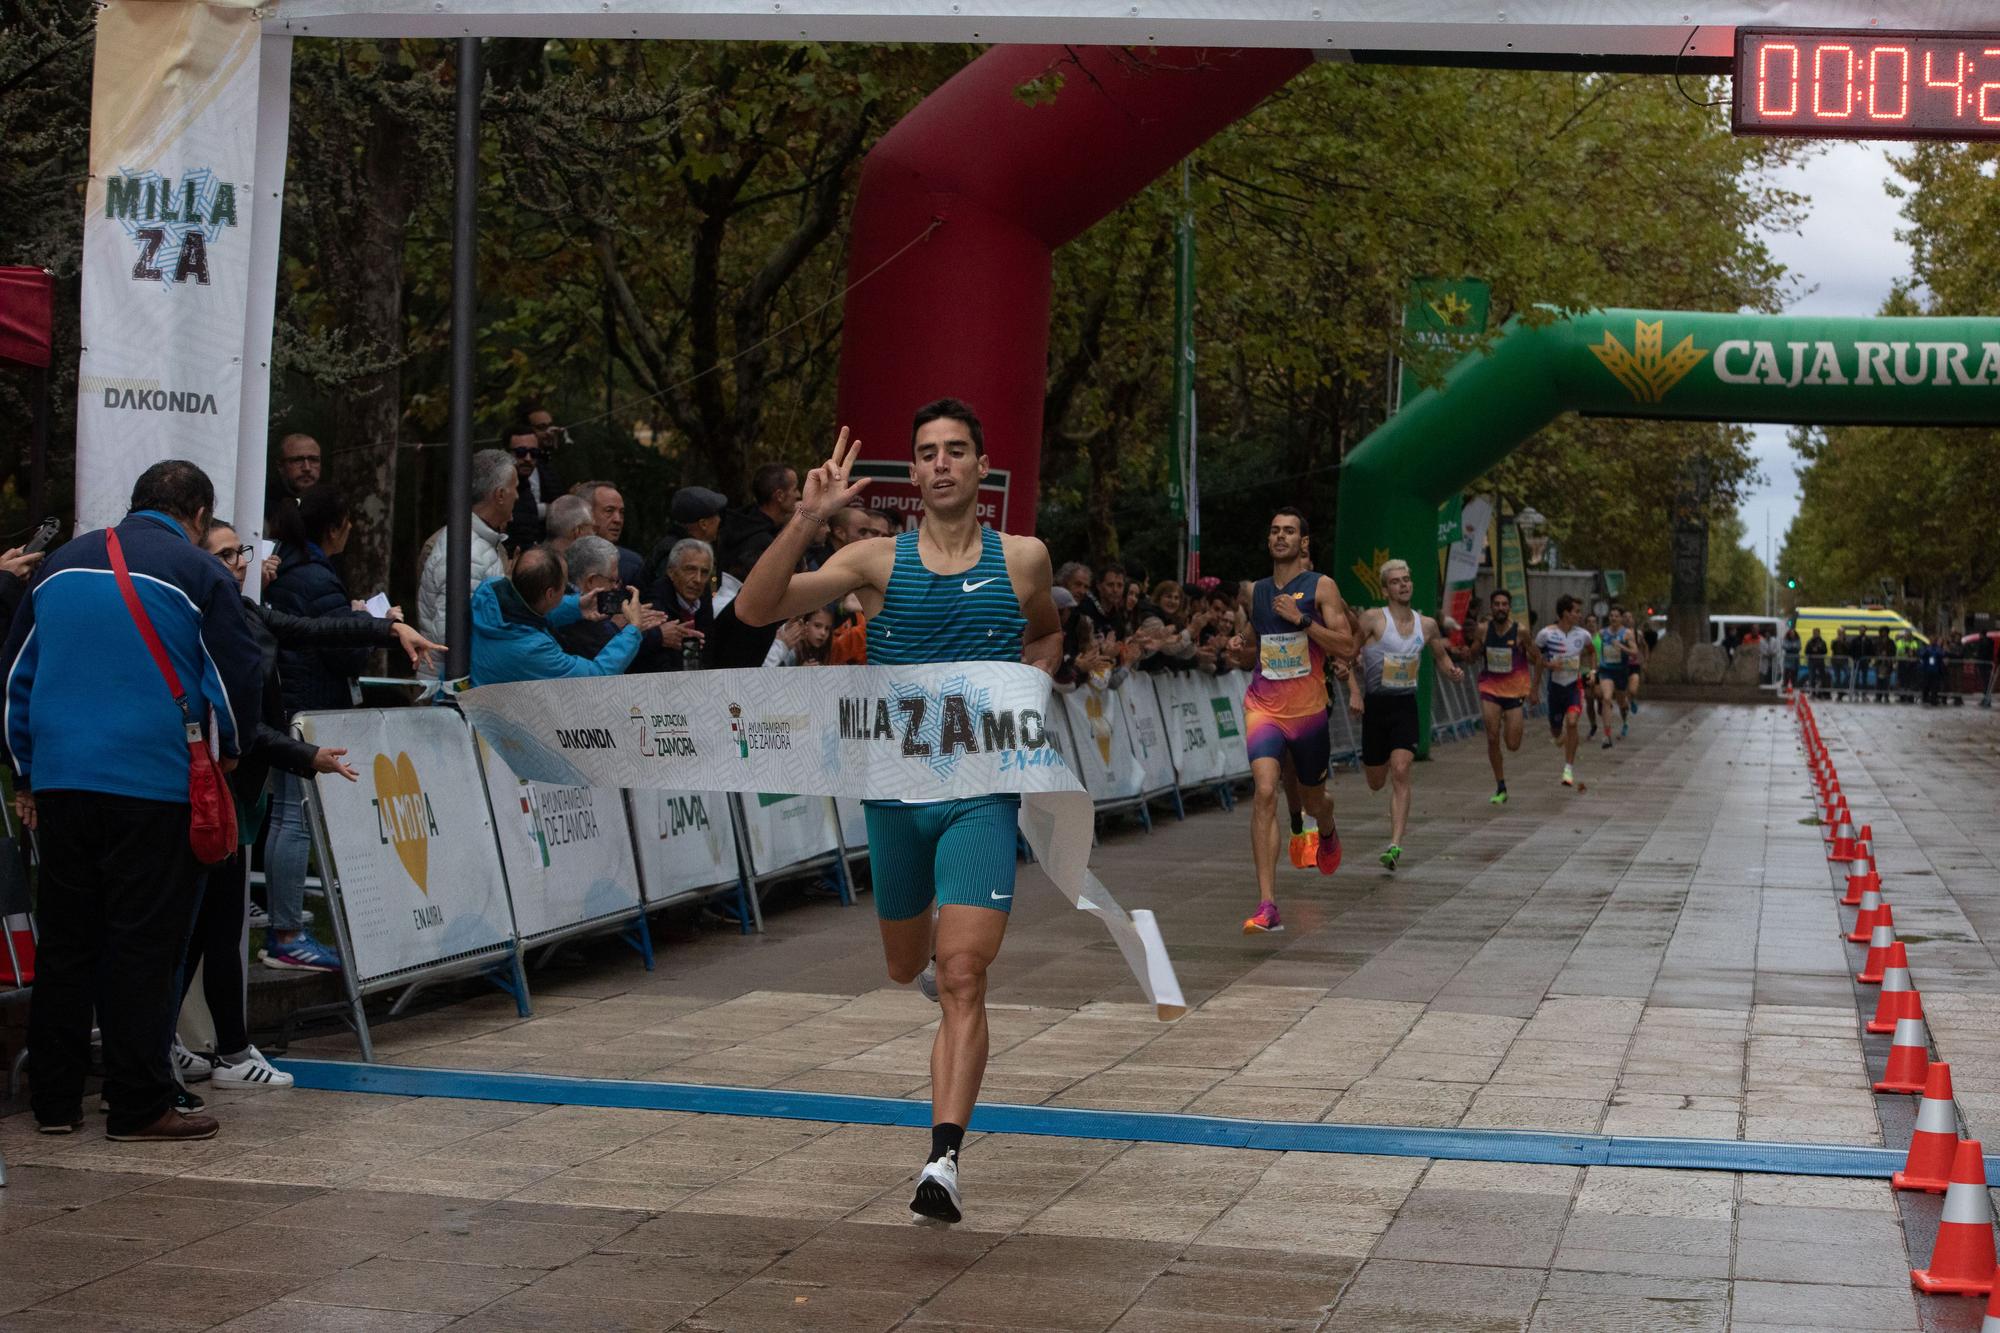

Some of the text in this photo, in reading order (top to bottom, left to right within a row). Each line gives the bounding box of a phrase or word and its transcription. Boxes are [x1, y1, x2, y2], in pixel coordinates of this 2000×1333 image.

[105, 175, 237, 227] MILLA
[132, 227, 210, 285] ZA
[1713, 339, 1849, 388] CAJA
[104, 387, 218, 415] DAKONDA
[871, 495, 926, 511] DIPUTA
[748, 722, 790, 734] AYUNTAMIENTO
[839, 696, 895, 741] MILLA
[556, 729, 616, 749] DAKONDA
[655, 737, 698, 757] ZAMORA
[749, 734, 791, 750] DE ZAMORA
[371, 792, 439, 845] ZAMORA
[559, 809, 599, 845] ZAMORA
